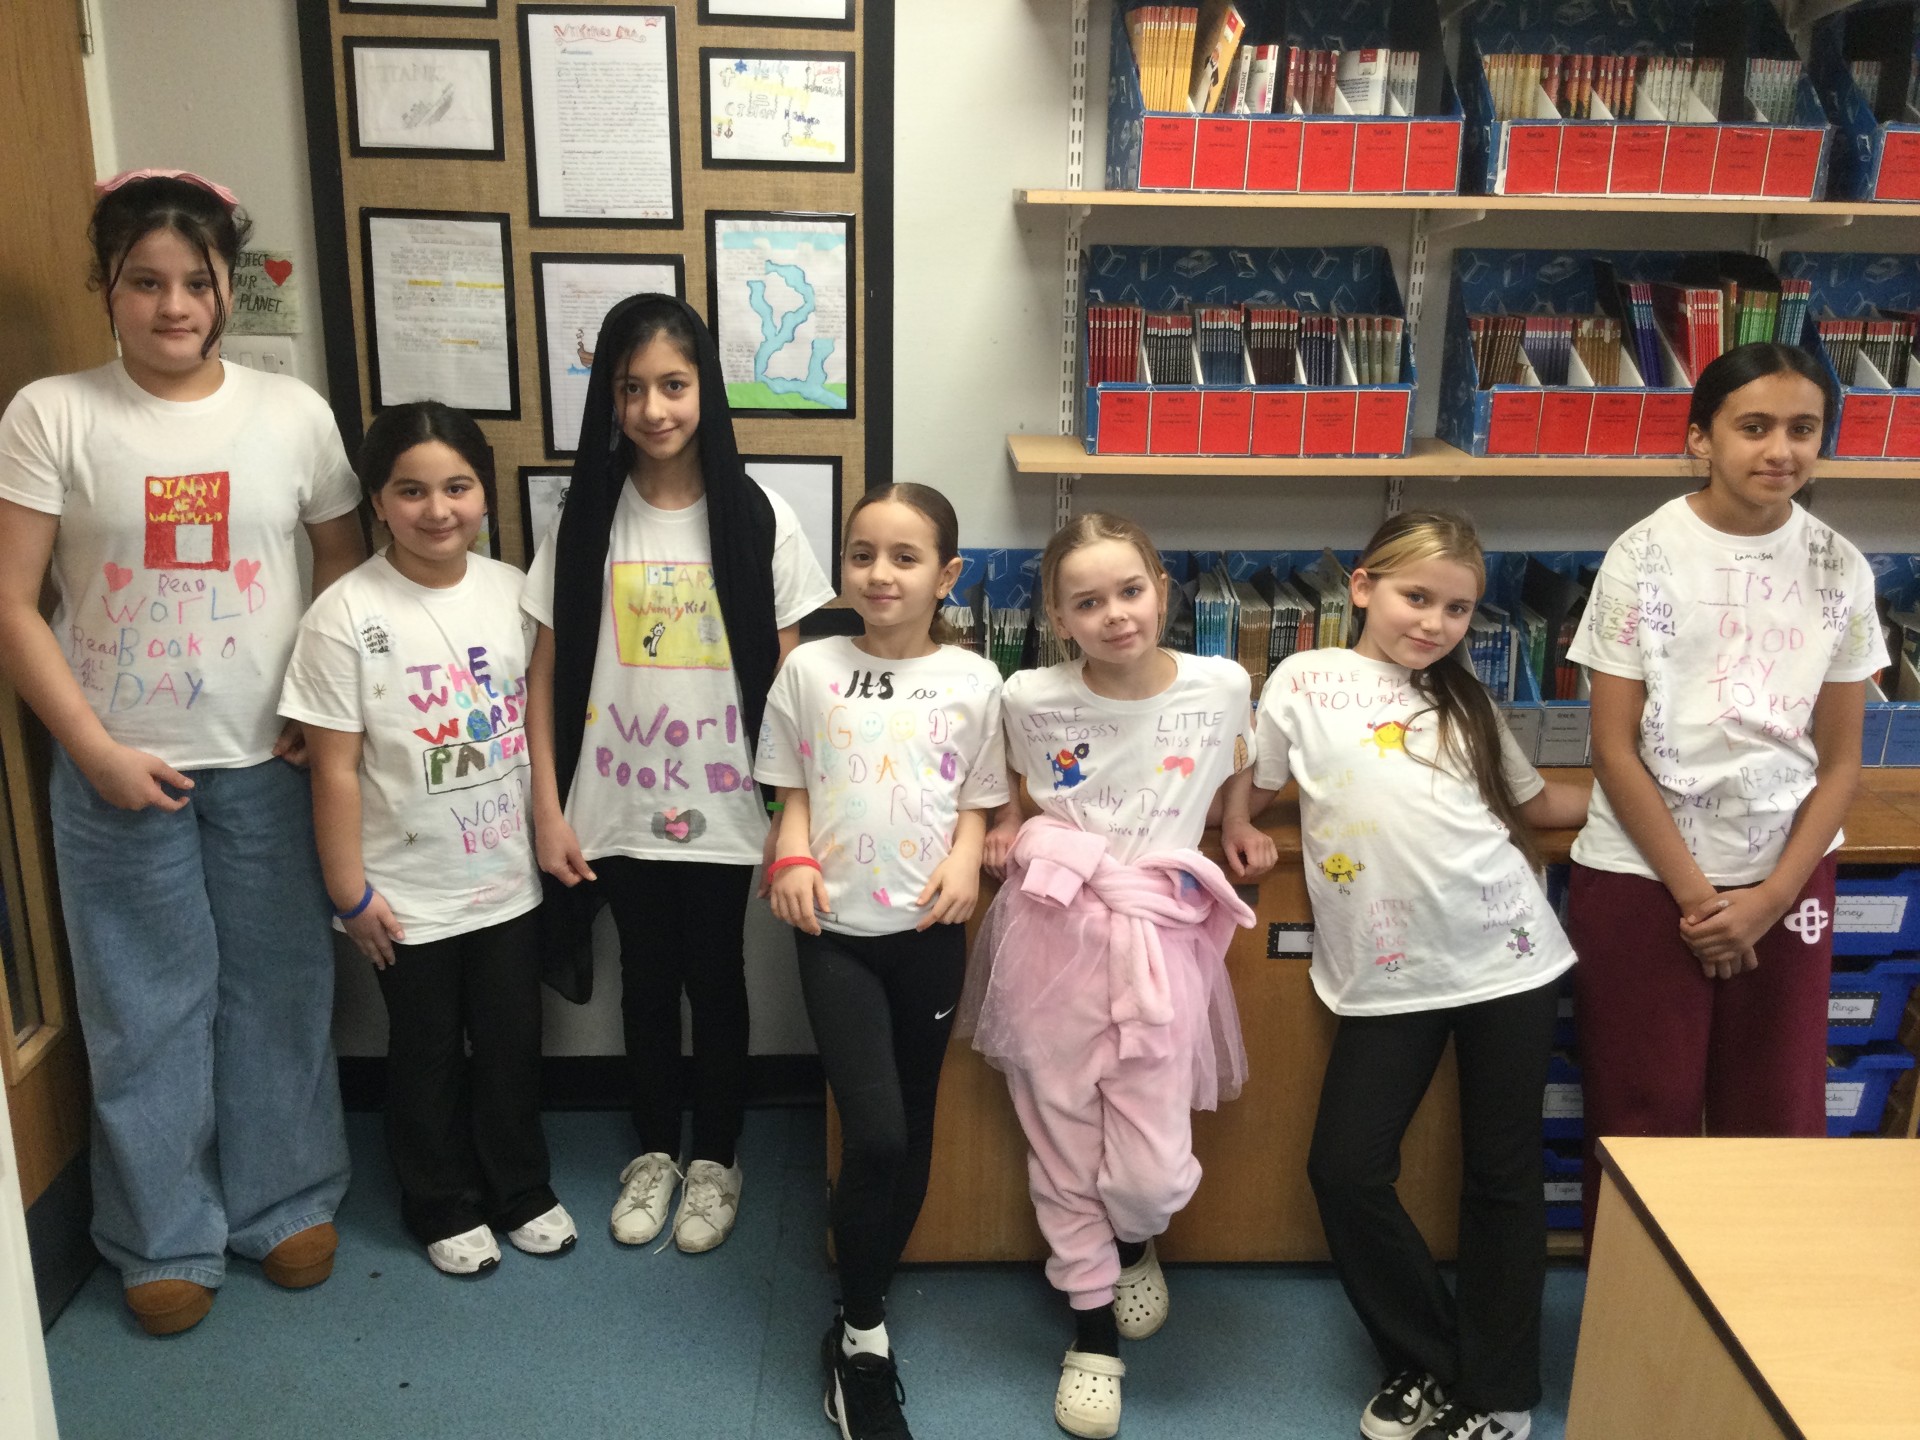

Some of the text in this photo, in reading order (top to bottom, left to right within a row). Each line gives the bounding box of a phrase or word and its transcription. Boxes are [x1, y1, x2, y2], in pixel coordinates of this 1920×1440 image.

[239, 292, 283, 312] PLANET
[1782, 579, 1803, 606] A
[406, 646, 493, 692] THE
[109, 671, 205, 713] DAY
[608, 702, 738, 748] Worl
[1020, 705, 1084, 733] LITTLE
[1157, 711, 1224, 733] LITTLE
[1154, 734, 1191, 748] MISS
[1832, 1003, 1860, 1014] Rings
